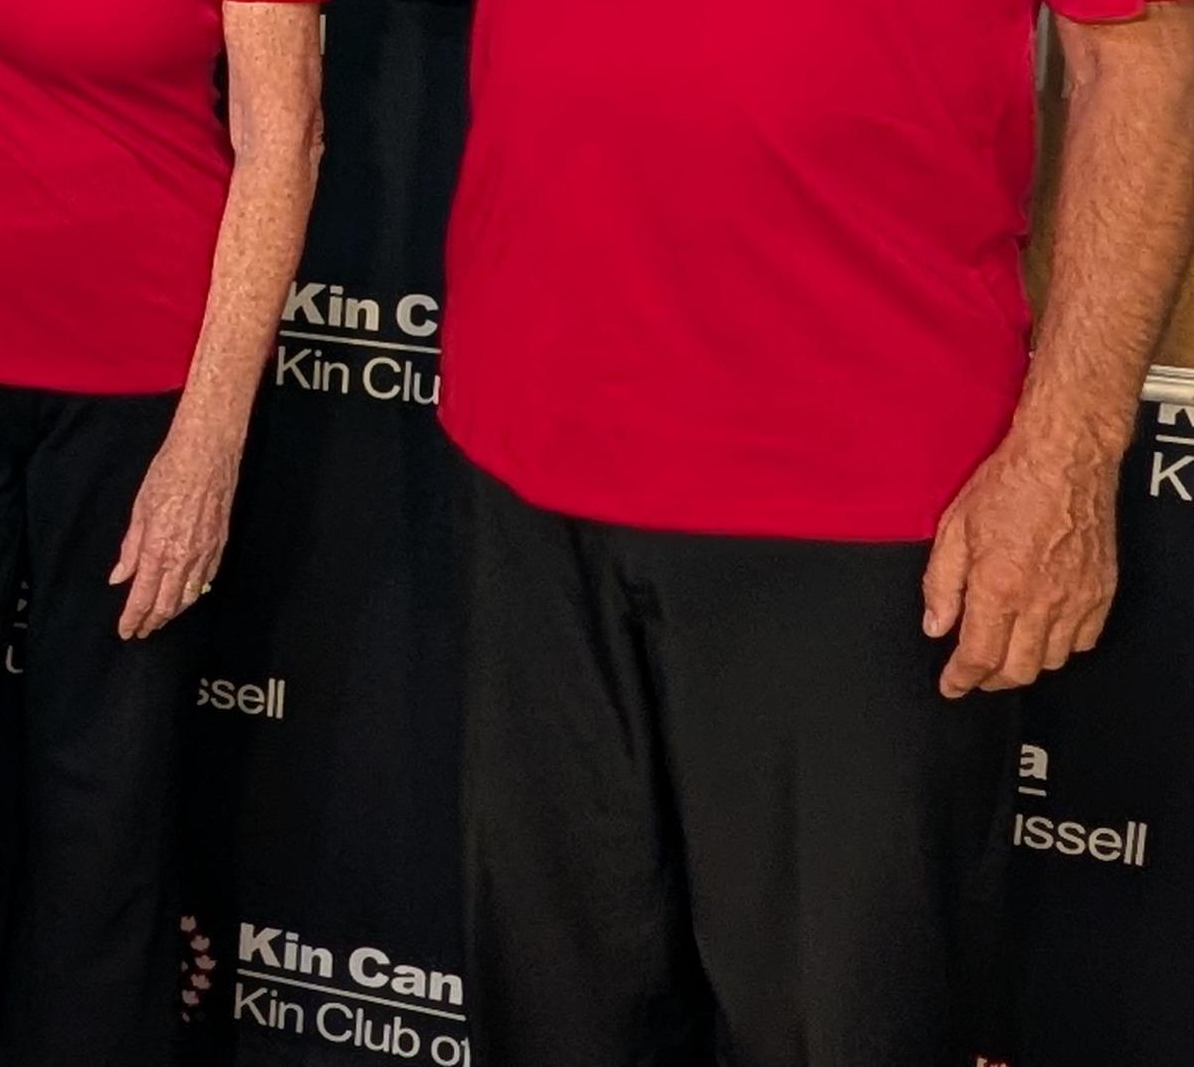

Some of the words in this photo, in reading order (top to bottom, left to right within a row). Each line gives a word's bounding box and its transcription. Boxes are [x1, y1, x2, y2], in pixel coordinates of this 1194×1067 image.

[281, 281, 380, 332] Kin
[276, 345, 350, 395] Kin
[362, 356, 441, 406] Clu
[197, 677, 286, 719] sell
[1013, 813, 1148, 867] ssell
[238, 922, 333, 979] Kin
[348, 946, 464, 1006] Can
[233, 982, 305, 1034] Kin
[316, 1002, 422, 1059] Club
